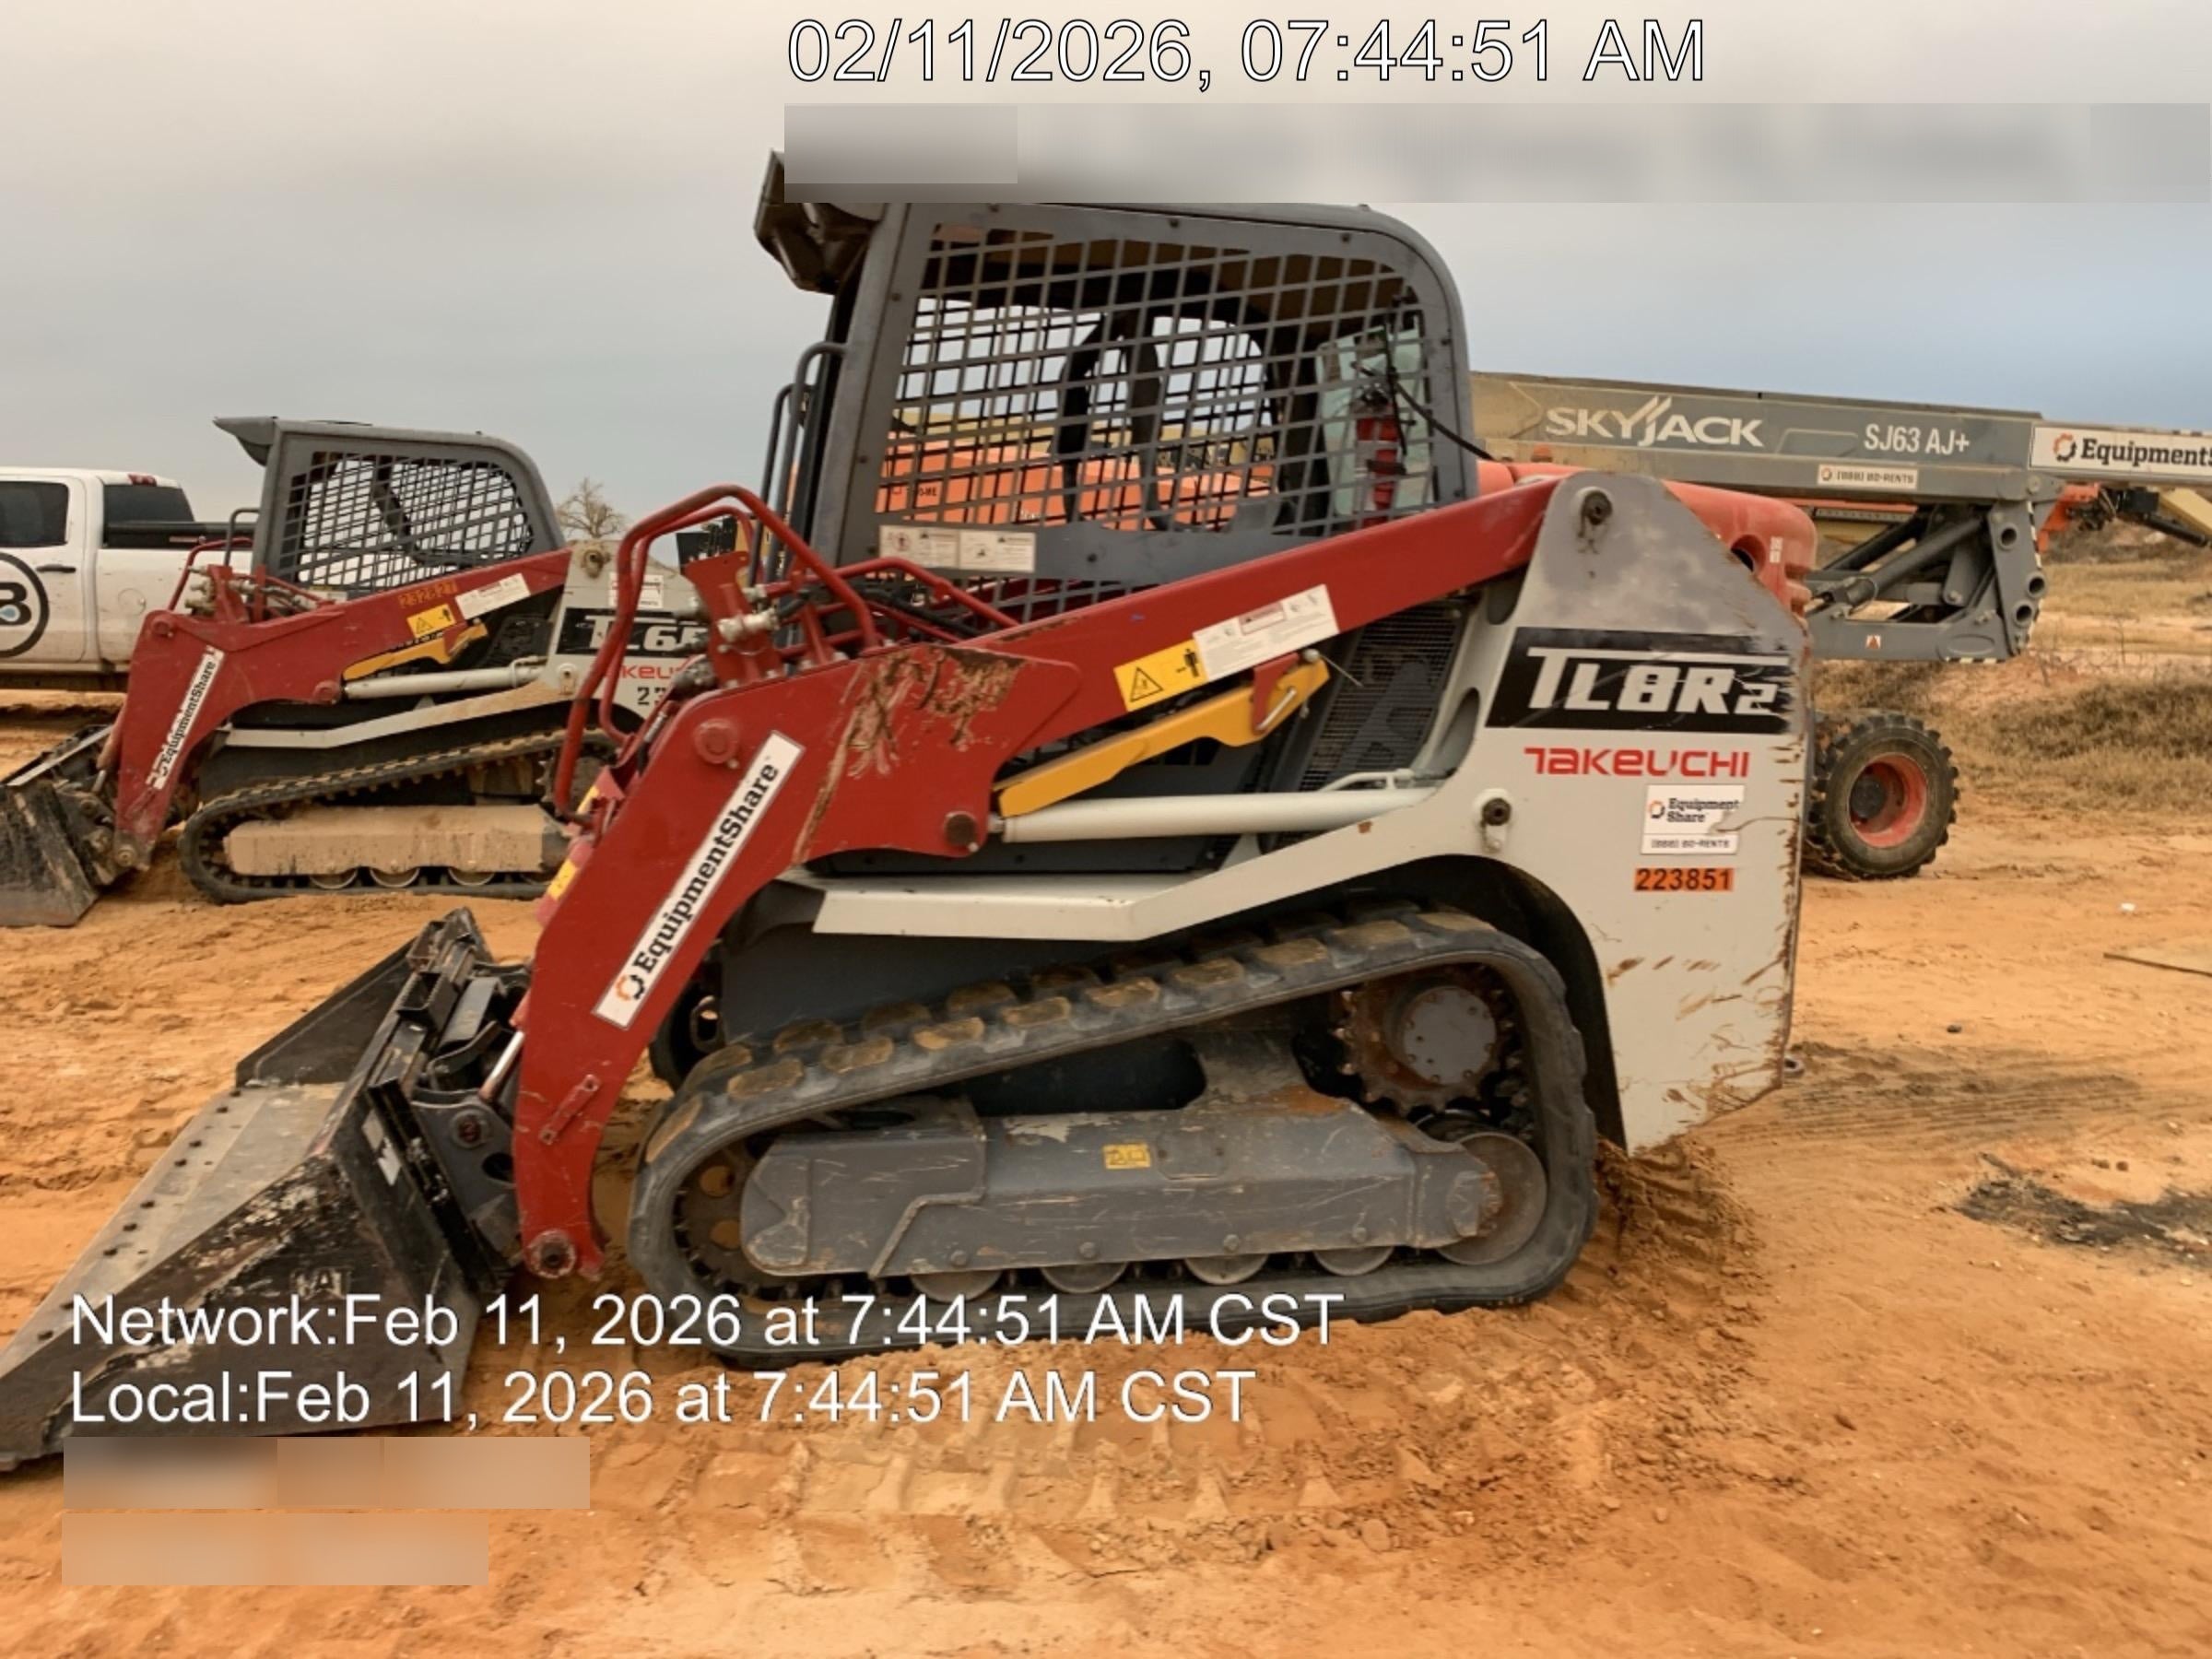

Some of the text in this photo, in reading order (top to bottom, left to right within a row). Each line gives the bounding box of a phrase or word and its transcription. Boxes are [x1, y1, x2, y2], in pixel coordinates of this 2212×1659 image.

[1546, 395, 1970, 455] SKYJACK SJ63 AJ+
[1524, 747, 1750, 778] TAKEUCHI
[1667, 810, 1706, 823] Share
[1668, 797, 1740, 812] Equipment
[633, 763, 779, 974] EquipmentShare
[1635, 867, 1731, 891] 223851
